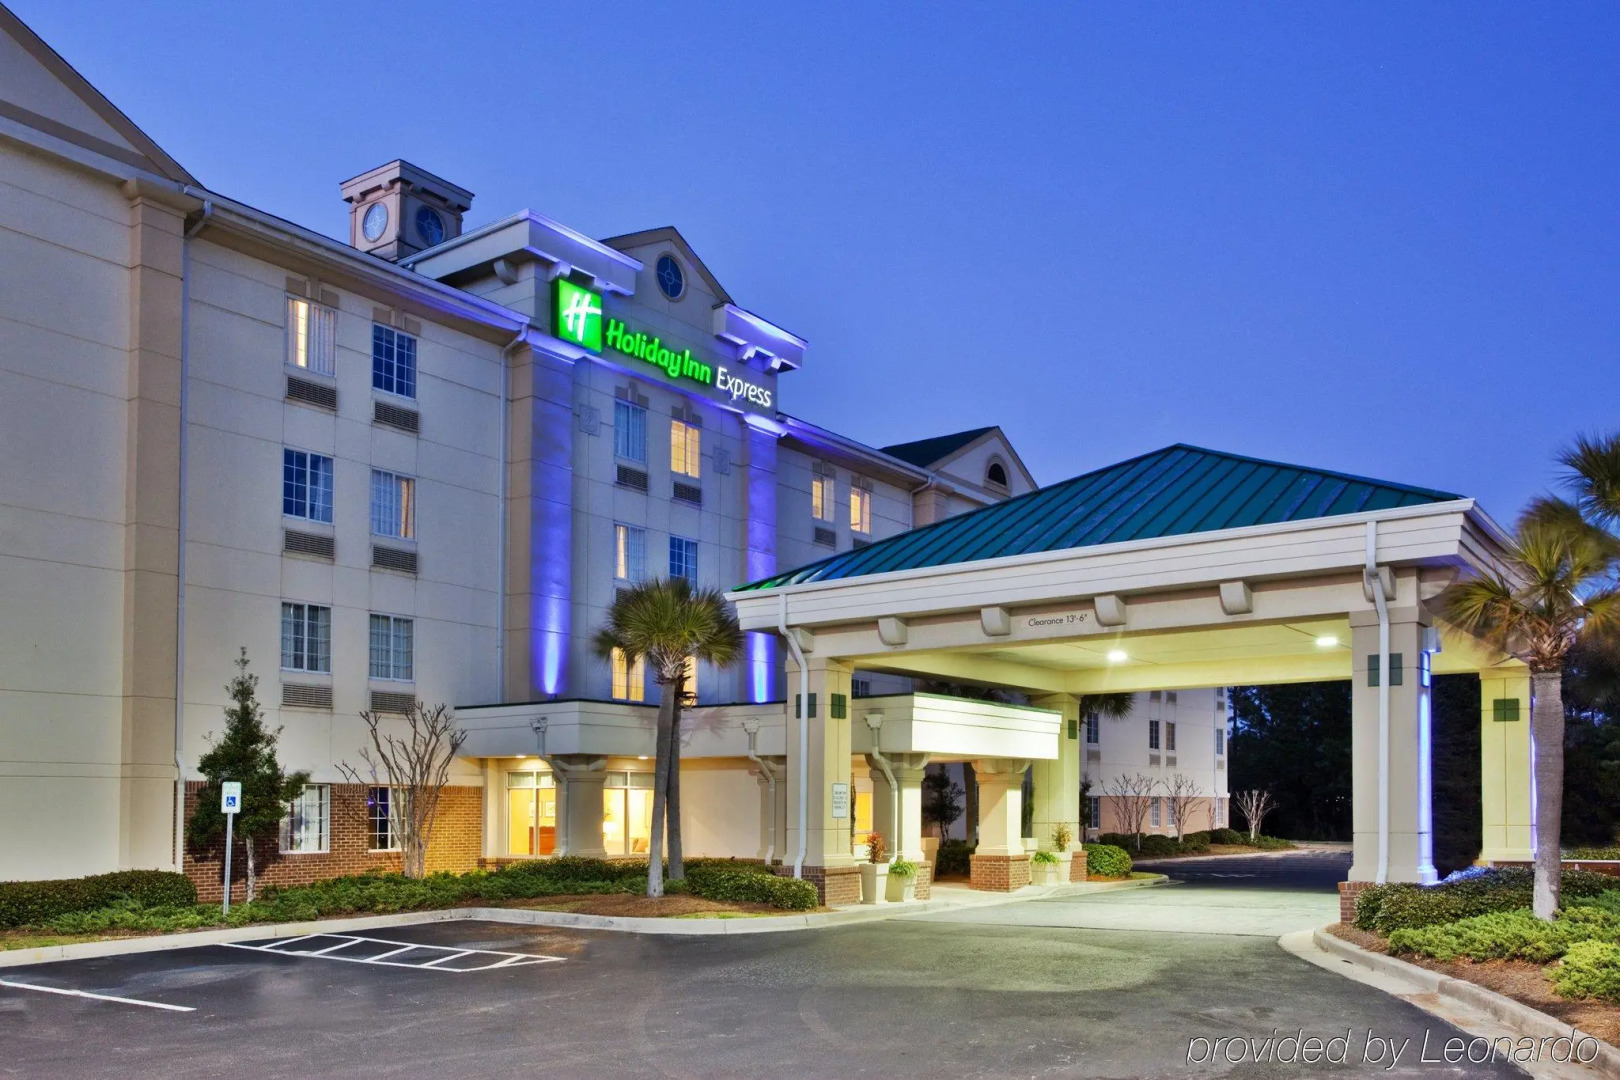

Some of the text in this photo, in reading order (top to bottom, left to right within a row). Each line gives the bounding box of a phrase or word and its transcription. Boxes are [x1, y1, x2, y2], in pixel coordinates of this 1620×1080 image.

[605, 318, 713, 385] Holiday Inn
[715, 366, 772, 408] Express
[1028, 617, 1064, 627] Clearance
